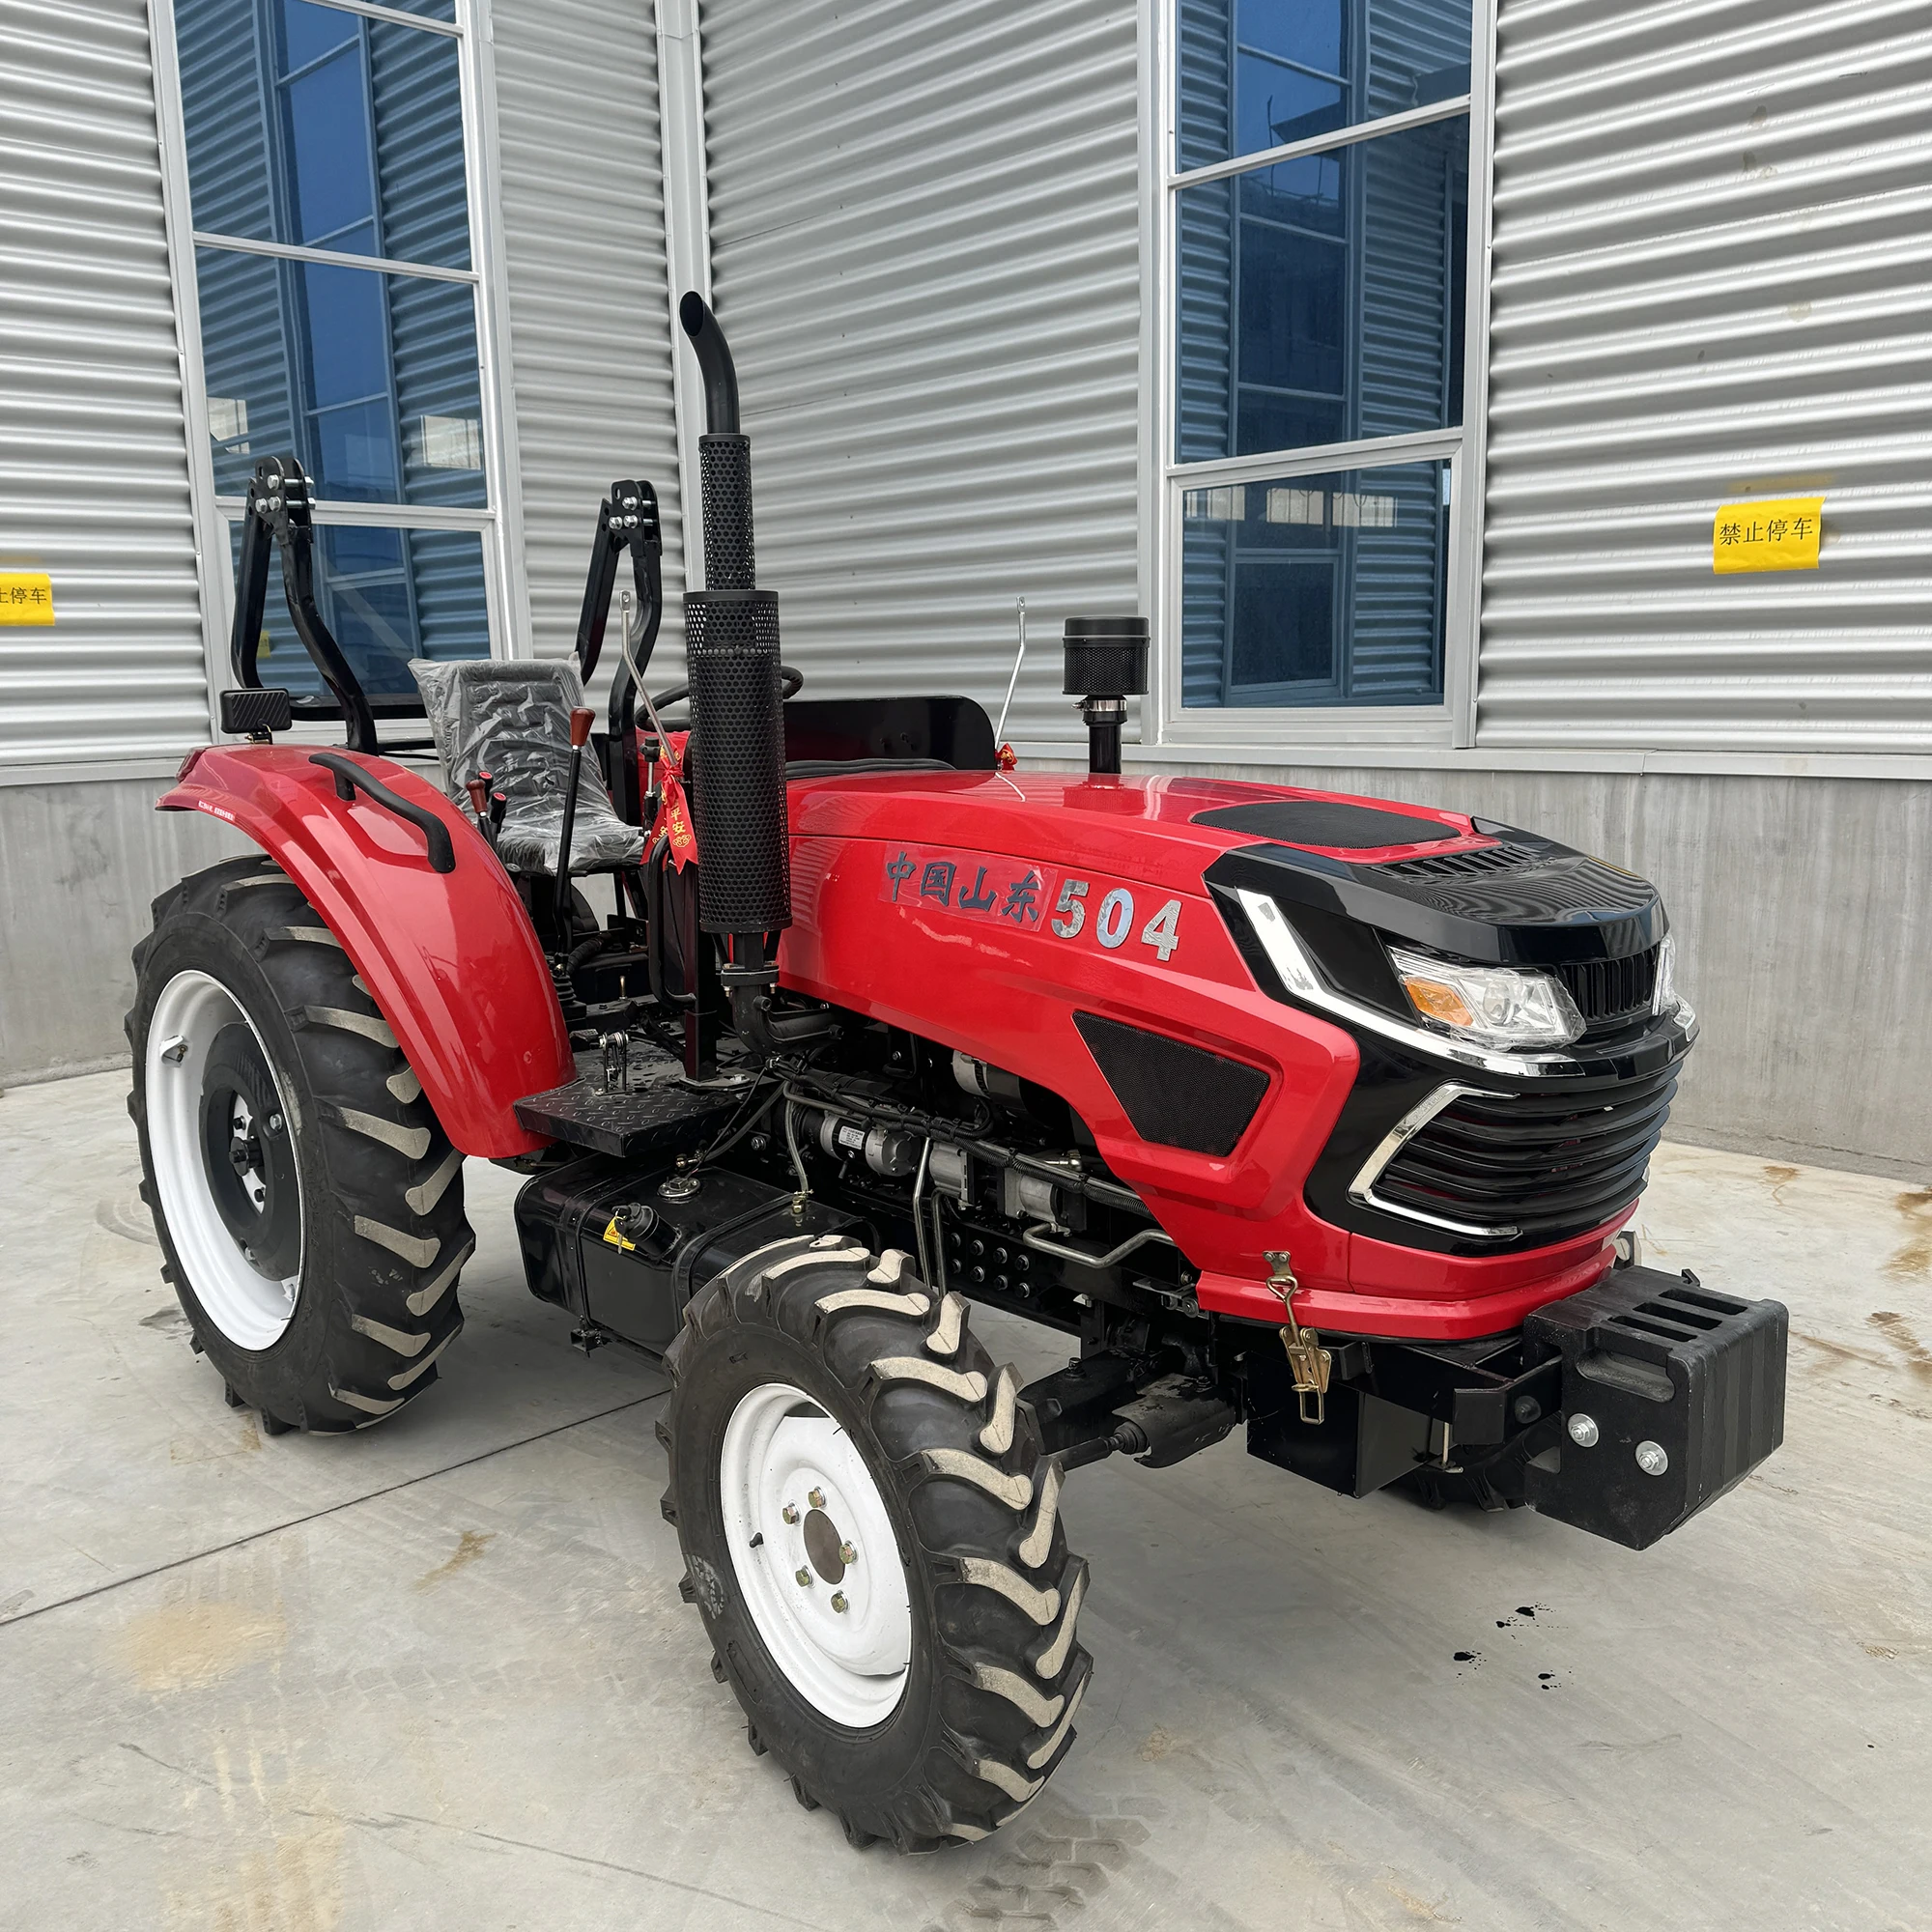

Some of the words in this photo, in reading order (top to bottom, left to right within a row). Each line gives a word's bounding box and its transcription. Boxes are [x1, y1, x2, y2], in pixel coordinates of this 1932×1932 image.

[1719, 517, 1813, 546] 禁止停车
[886, 851, 1039, 923] 中国山东
[1051, 878, 1182, 962] 504
